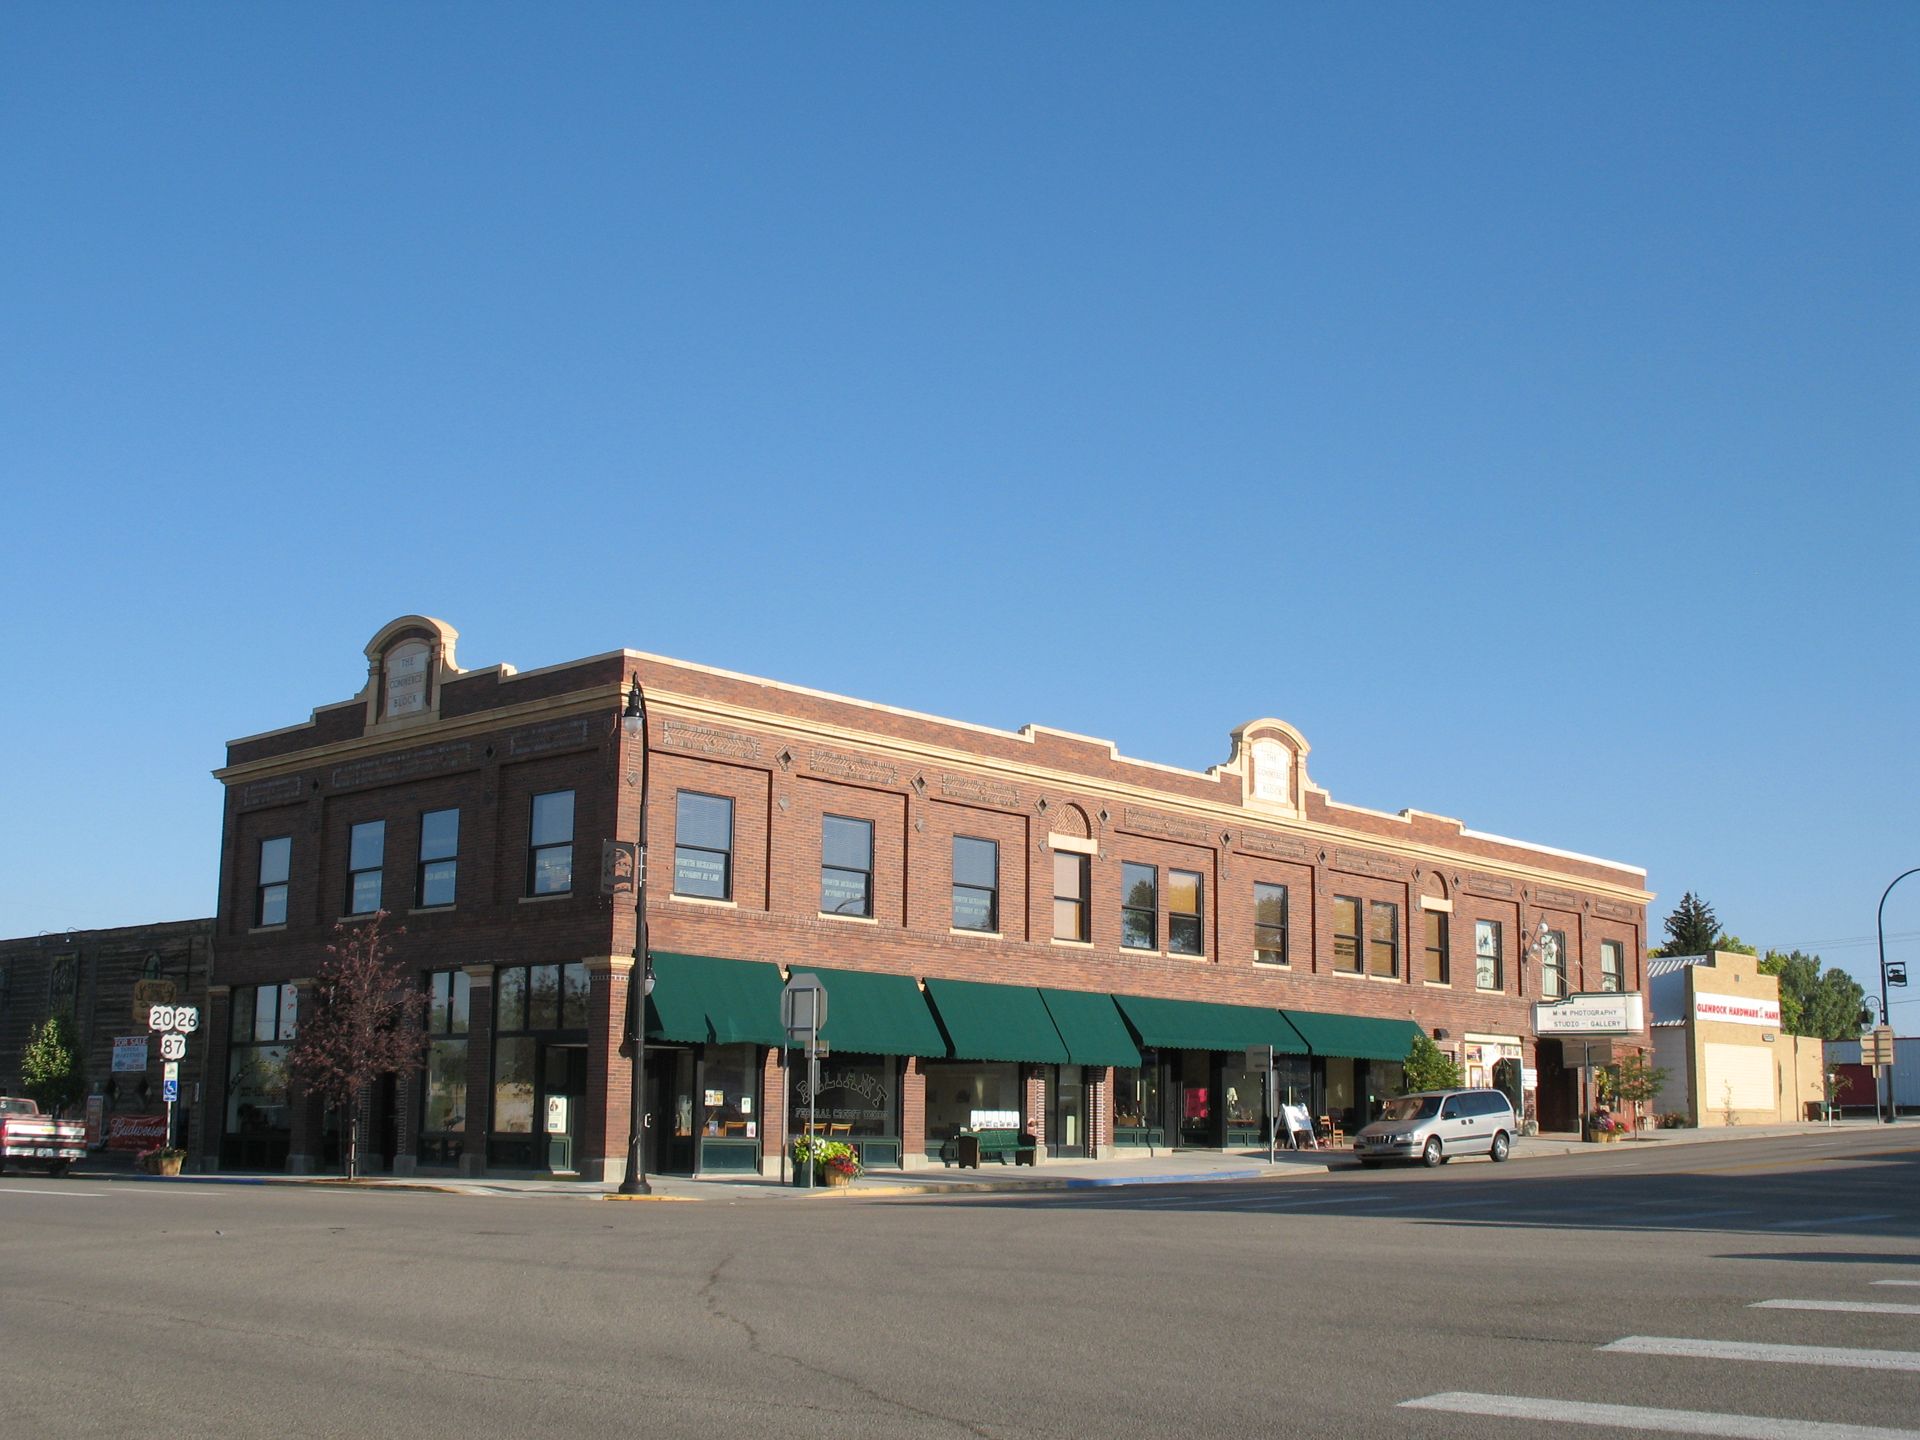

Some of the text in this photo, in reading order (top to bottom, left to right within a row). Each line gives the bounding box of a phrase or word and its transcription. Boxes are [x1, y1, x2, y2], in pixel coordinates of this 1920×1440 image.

[401, 656, 416, 668] THE
[393, 695, 417, 708] BLOCK
[1697, 1003, 1727, 1014] GLENROCK
[1729, 1007, 1758, 1018] HARDWARE
[152, 1010, 172, 1026] 20
[177, 1012, 197, 1028] 26
[114, 1038, 149, 1047] FOR SALE
[163, 1039, 183, 1055] 87
[795, 1108, 831, 1118] FEDRAL
